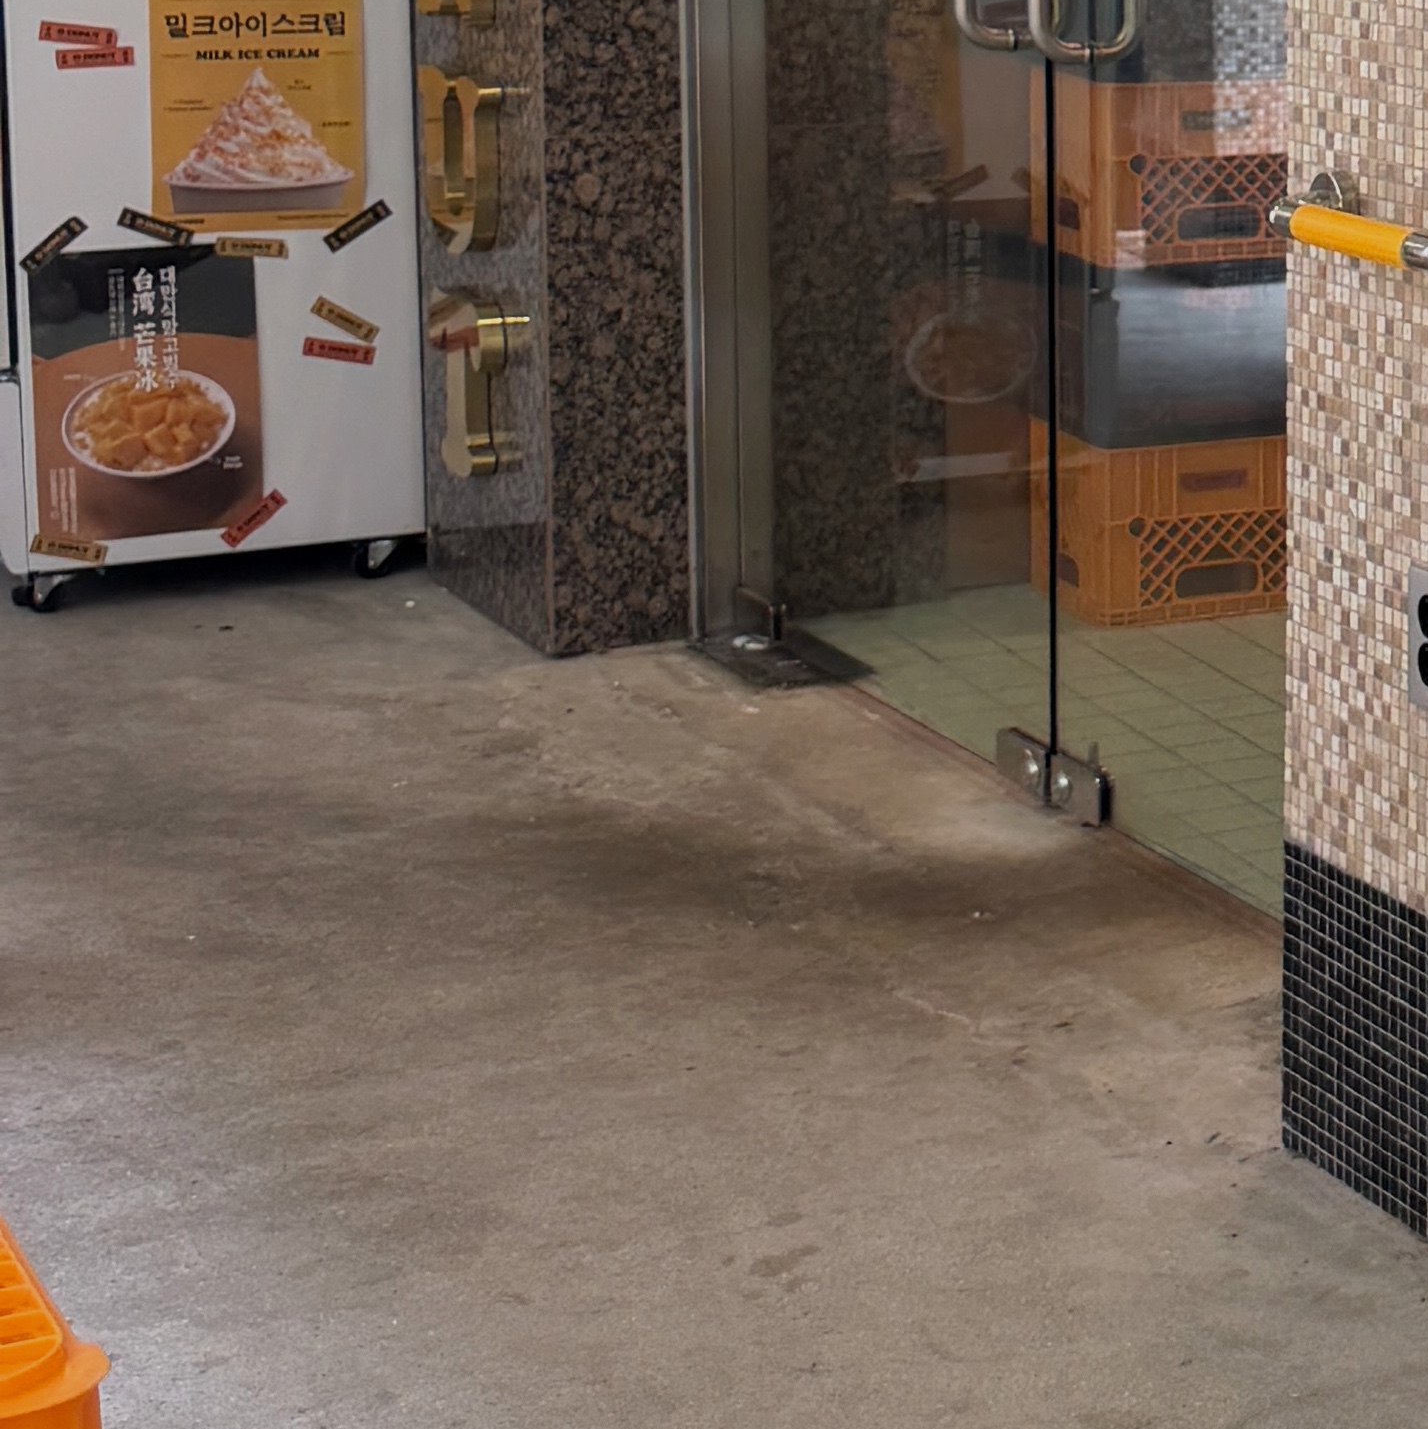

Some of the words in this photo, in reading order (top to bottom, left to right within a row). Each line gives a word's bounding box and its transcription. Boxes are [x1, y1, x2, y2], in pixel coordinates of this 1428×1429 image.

[164, 10, 346, 39] 밀크아이스크림
[196, 48, 233, 61] MILK
[238, 48, 262, 61] ICE
[266, 47, 320, 60] CREAM
